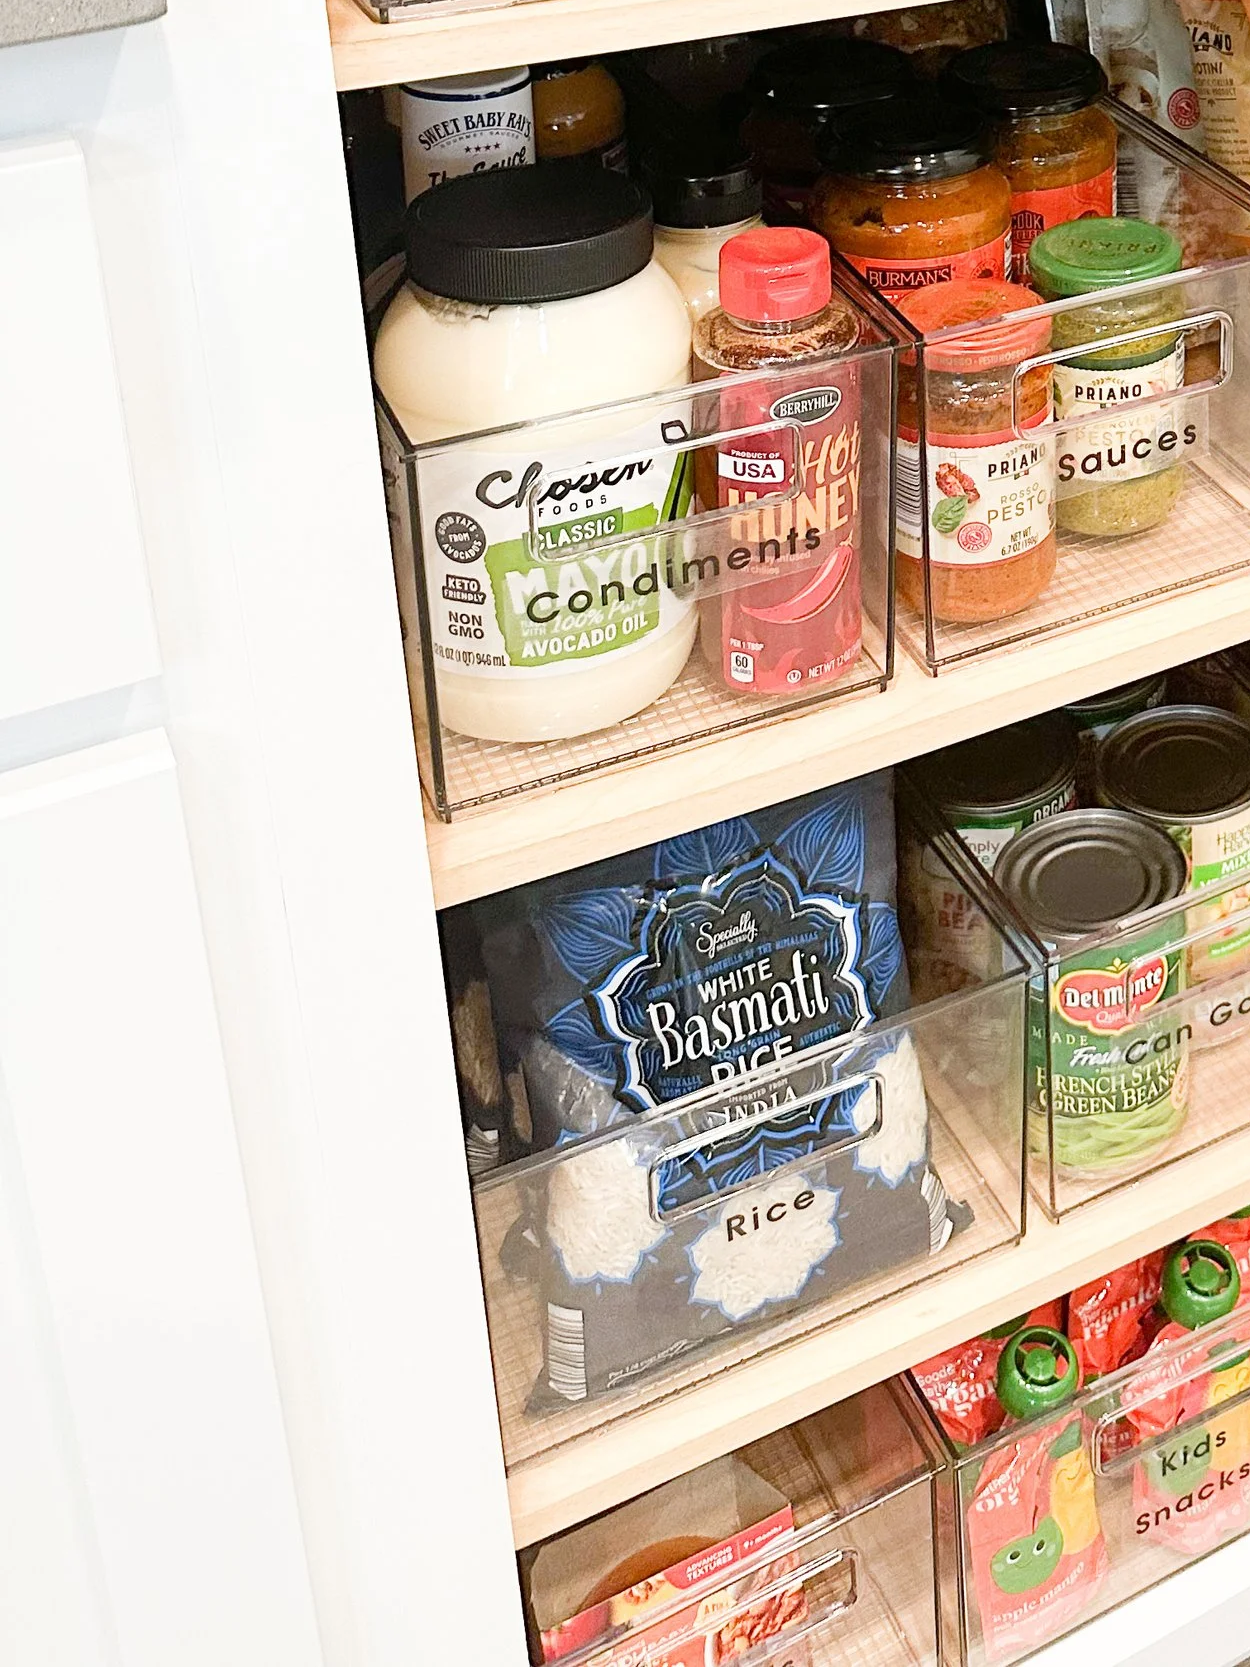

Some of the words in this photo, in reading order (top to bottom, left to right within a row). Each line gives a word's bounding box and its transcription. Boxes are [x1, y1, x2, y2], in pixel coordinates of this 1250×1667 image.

[418, 118, 460, 150] SWEET
[464, 112, 505, 130] BABY
[868, 268, 950, 287] BURMAN'S
[779, 391, 836, 416] BERRYHILL
[1075, 384, 1142, 400] PRIANO
[731, 449, 768, 459] PRODUCT
[769, 451, 780, 459] OF
[802, 424, 860, 484] Hot
[988, 443, 1046, 478] PRIANO
[1058, 424, 1196, 482] Sauces
[733, 460, 776, 479] USA
[538, 495, 607, 517] FOODS
[729, 461, 861, 542] HONEY
[987, 490, 1047, 525] PESTO
[1000, 482, 1039, 504] ROSSO
[438, 514, 455, 535] GOOD
[455, 516, 478, 533] FATS
[448, 533, 470, 542] FROM
[537, 515, 616, 551] CLASSIC
[442, 539, 483, 560] AVOCADOS
[448, 578, 478, 590] KETO
[505, 542, 648, 615] MAYO
[526, 524, 823, 625] Condiments
[444, 590, 485, 603] FRIENDLY
[448, 625, 485, 640] GMO
[449, 610, 483, 626] NON
[521, 624, 617, 659] AVOCADO
[622, 611, 648, 632] OIL
[735, 654, 748, 669] 60
[696, 911, 758, 958] Specially
[697, 957, 773, 1004] WHITE
[646, 950, 829, 1070] Basmati
[1065, 987, 1100, 1008] Del
[718, 1043, 747, 1061] LONG
[750, 1029, 781, 1047] GRAIN
[1070, 1046, 1121, 1067] Fresh
[1124, 1021, 1193, 1066] Can
[728, 1088, 767, 1104] IMPORTED
[1036, 1066, 1125, 1096] FRENCH
[1039, 1090, 1118, 1114] GREEN
[1123, 1063, 1176, 1109] BEANS
[725, 1187, 817, 1242] Rice
[1160, 1430, 1228, 1478] Kids
[686, 1544, 734, 1574] ADVANCING
[686, 1553, 733, 1581] TEXTURES
[1040, 1561, 1084, 1604] mango
